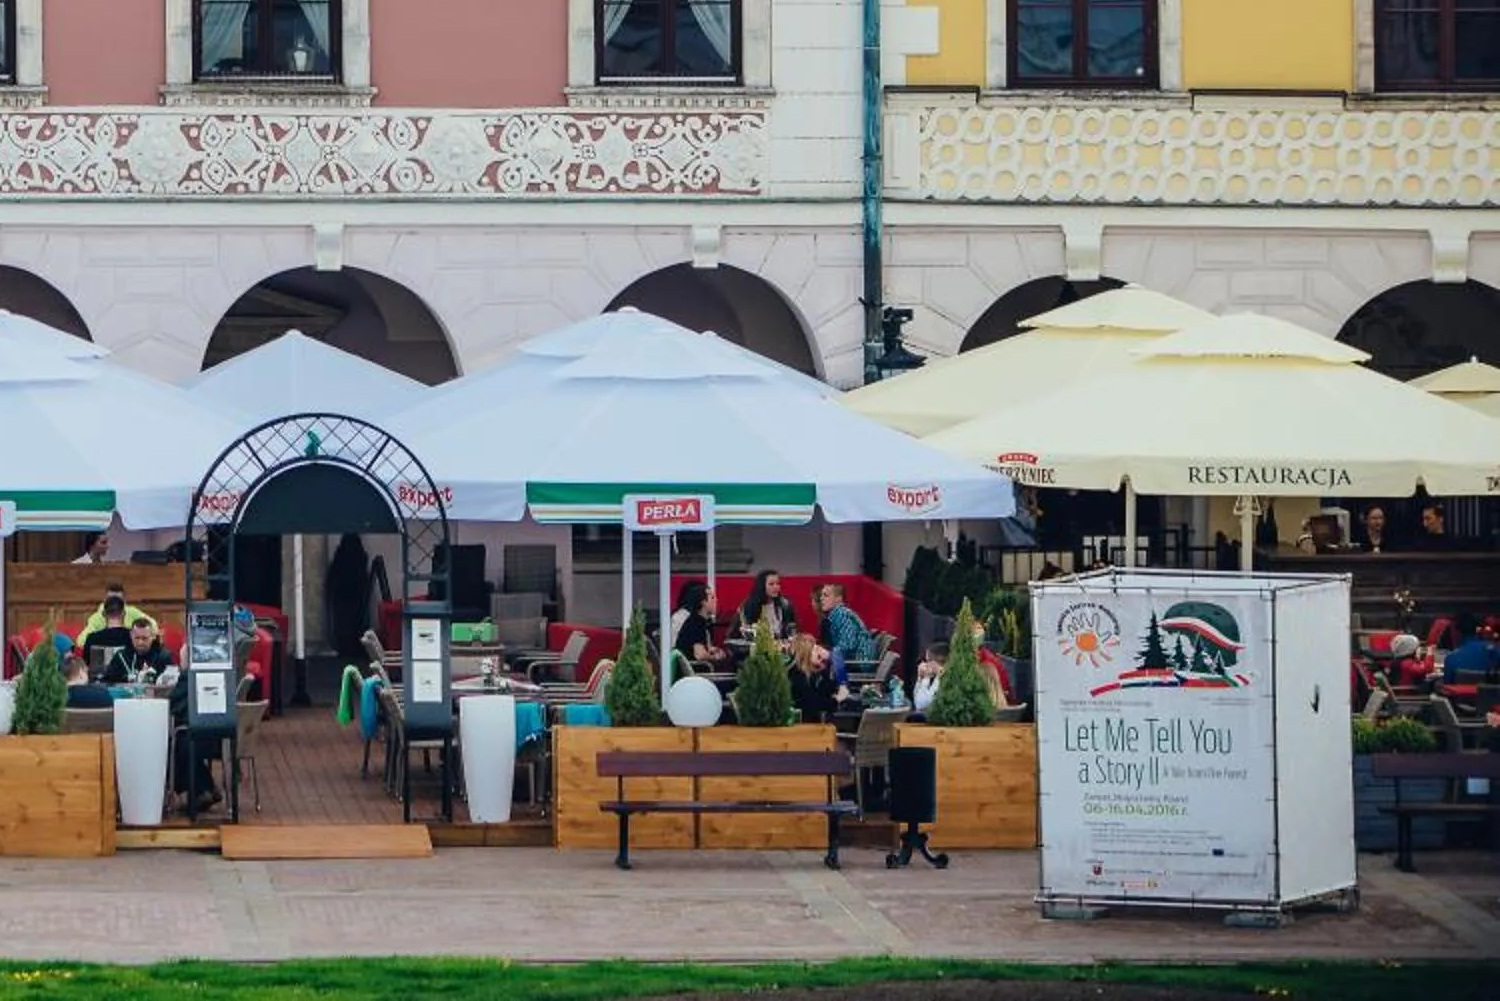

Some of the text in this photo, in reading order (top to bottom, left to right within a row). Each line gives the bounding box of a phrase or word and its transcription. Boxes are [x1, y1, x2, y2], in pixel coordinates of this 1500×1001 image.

[1188, 466, 1351, 488] RESTAURACJA
[887, 485, 939, 511] export
[1064, 717, 1232, 755] Let Me Tell You
[1078, 761, 1089, 784] a
[1095, 754, 1145, 791] Story
